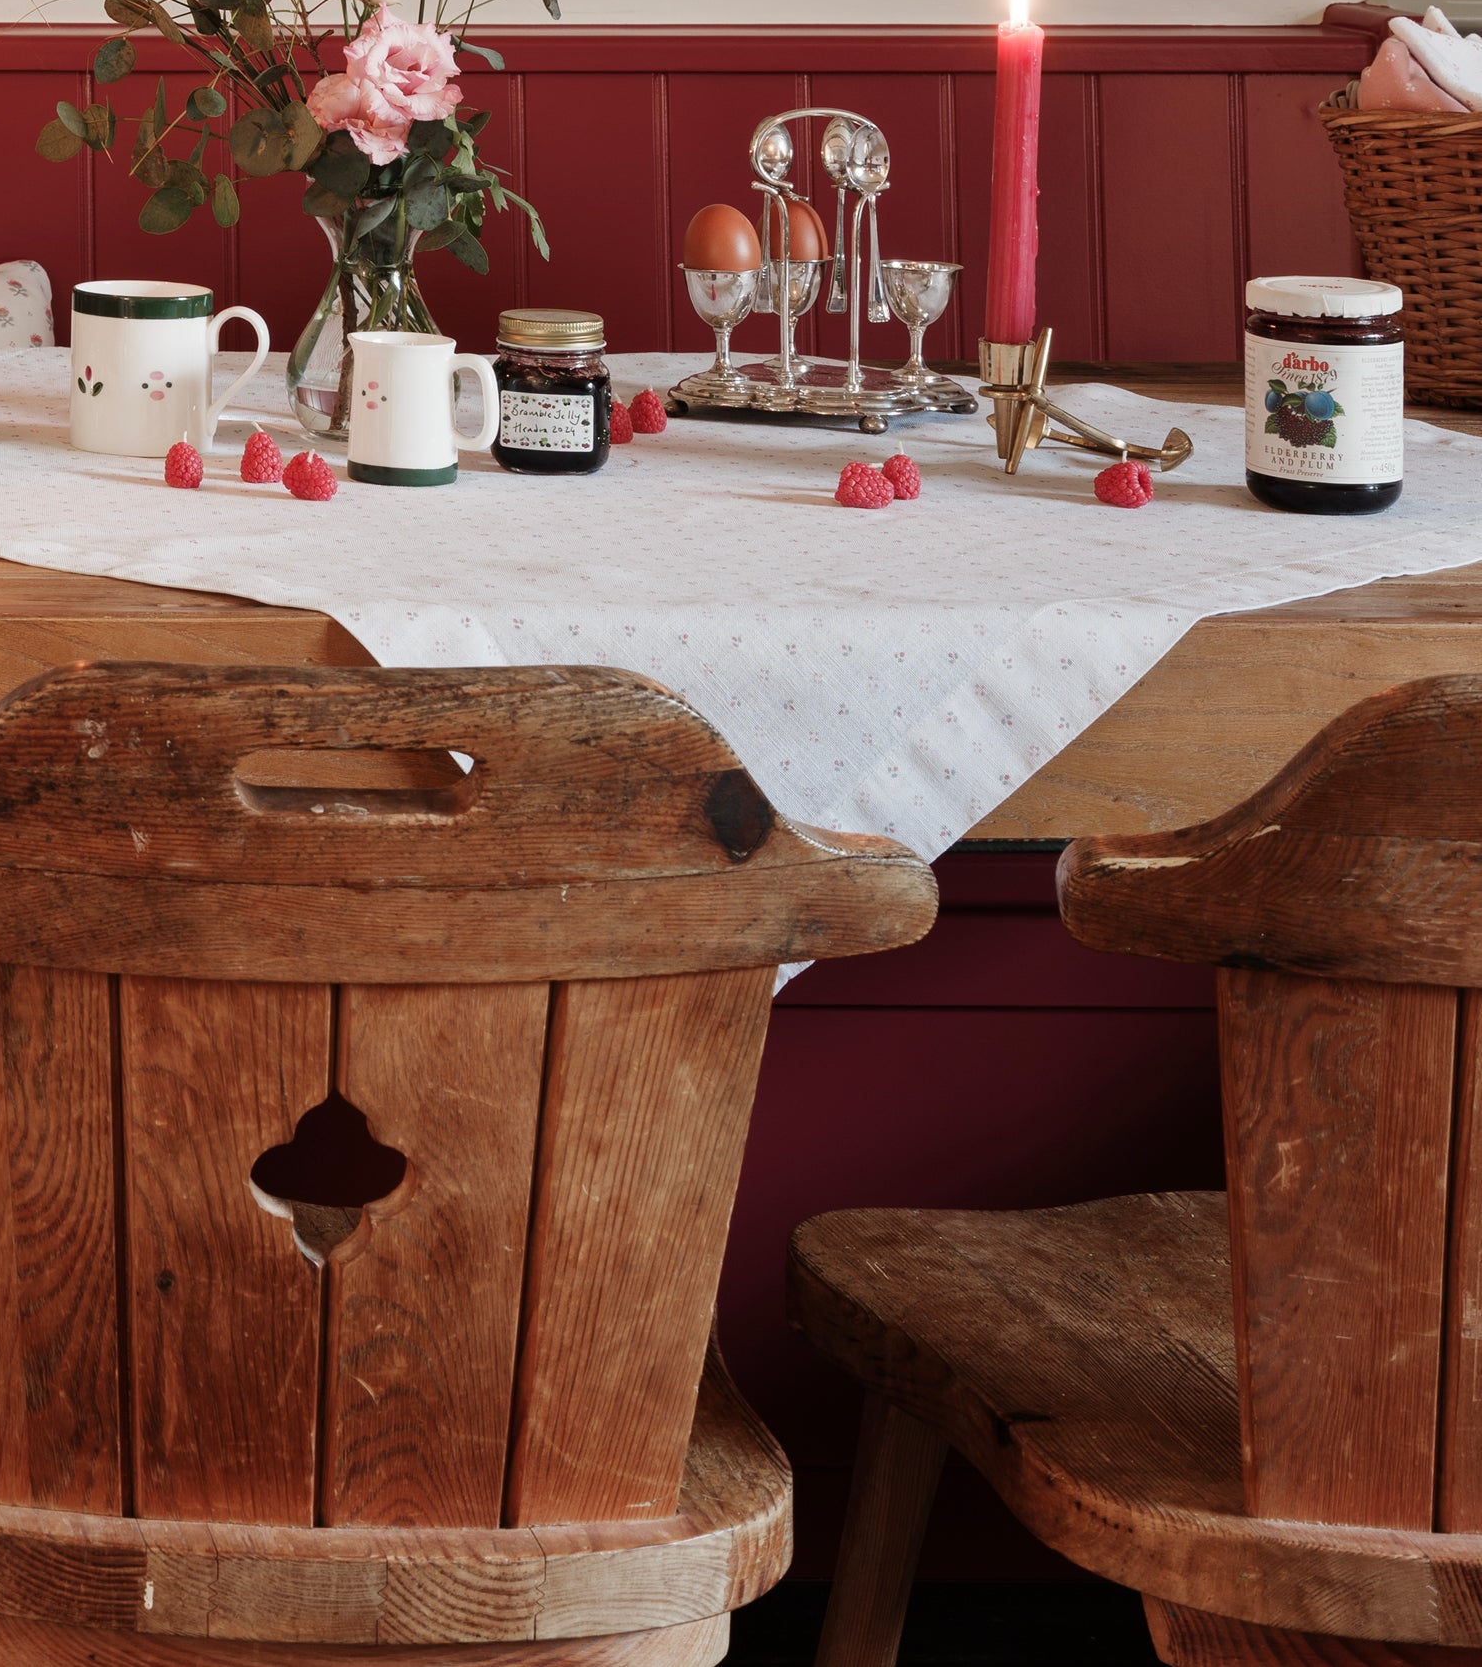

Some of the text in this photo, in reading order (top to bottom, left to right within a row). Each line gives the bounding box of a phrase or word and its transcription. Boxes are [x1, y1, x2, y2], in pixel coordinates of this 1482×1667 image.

[1271, 361, 1338, 384] Since 1879
[511, 404, 581, 426] Bramble Jelly
[1264, 444, 1344, 462] ELDERBERRY
[1271, 455, 1335, 470] AND PLUM
[1278, 466, 1324, 478] Fruit Preserve
